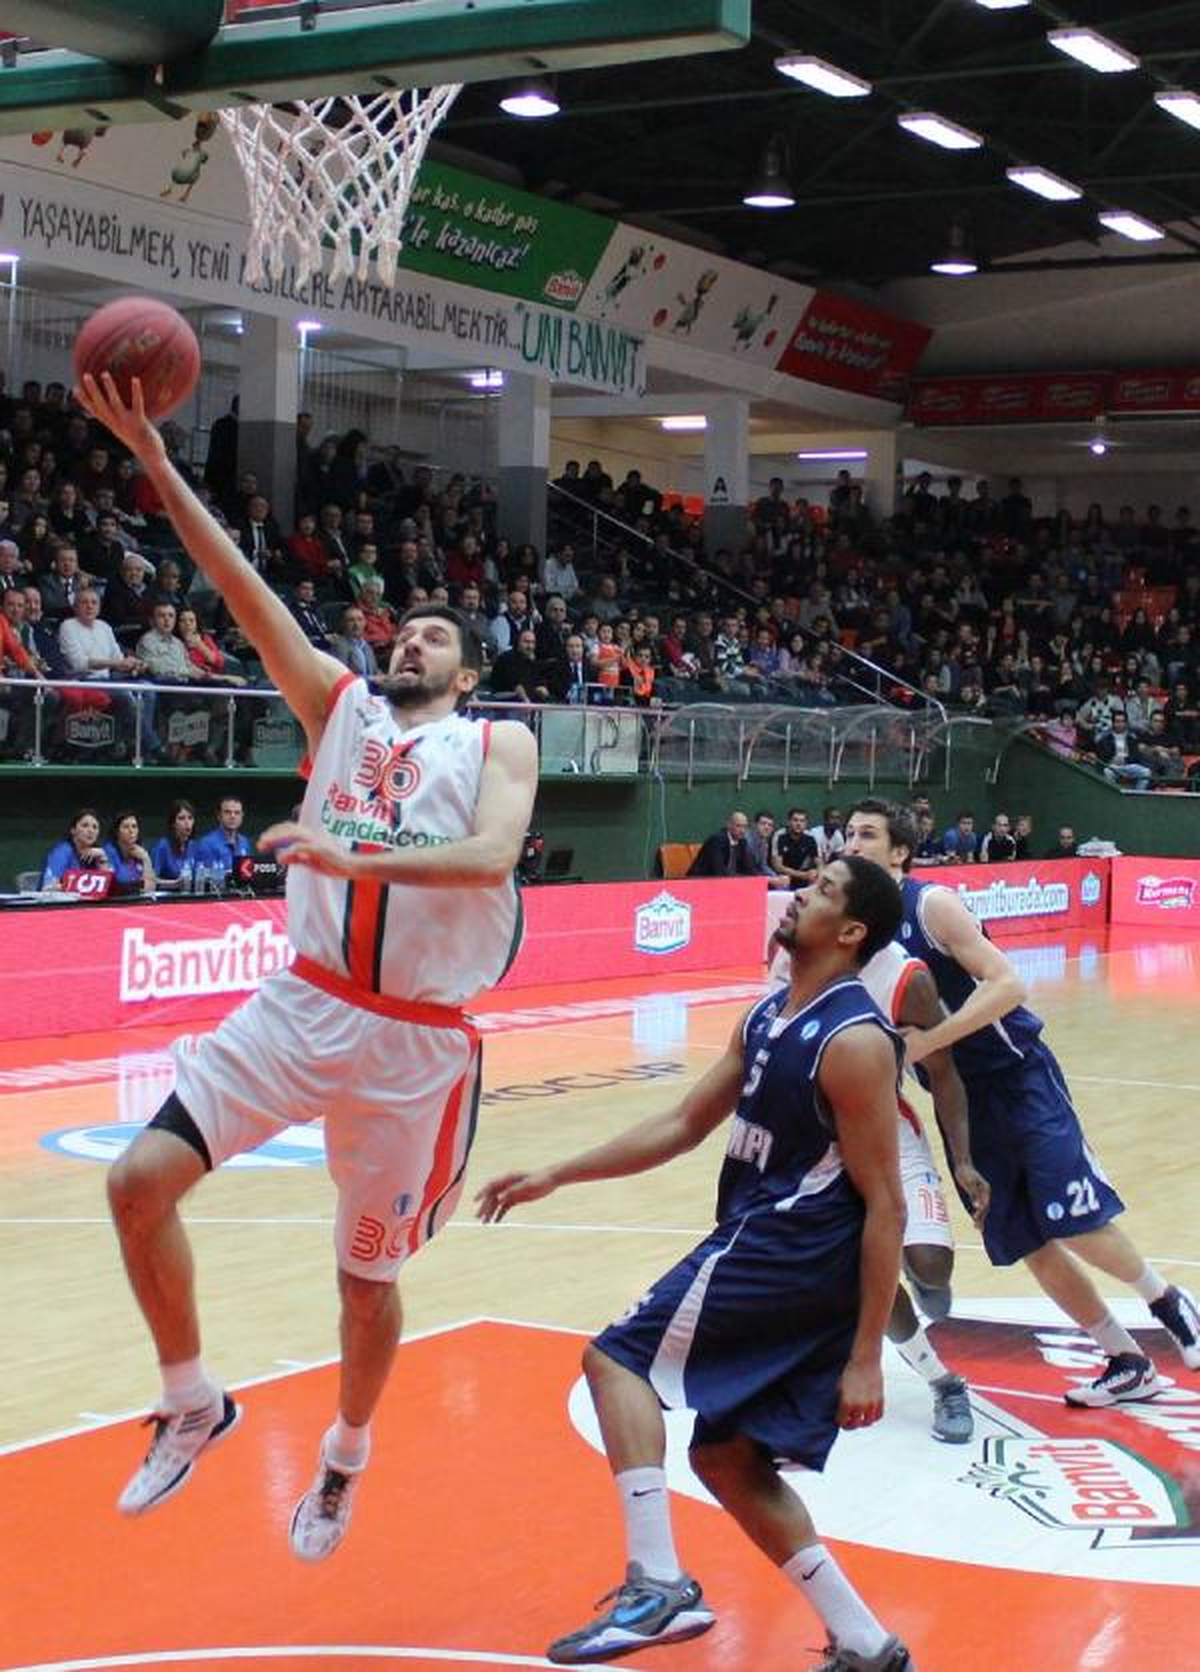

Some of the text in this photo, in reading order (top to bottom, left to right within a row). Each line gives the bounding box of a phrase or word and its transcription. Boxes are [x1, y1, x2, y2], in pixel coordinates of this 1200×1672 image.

[713, 476, 728, 495] A
[639, 916, 685, 940] Banvit
[1028, 1443, 1158, 1521] Banvit
